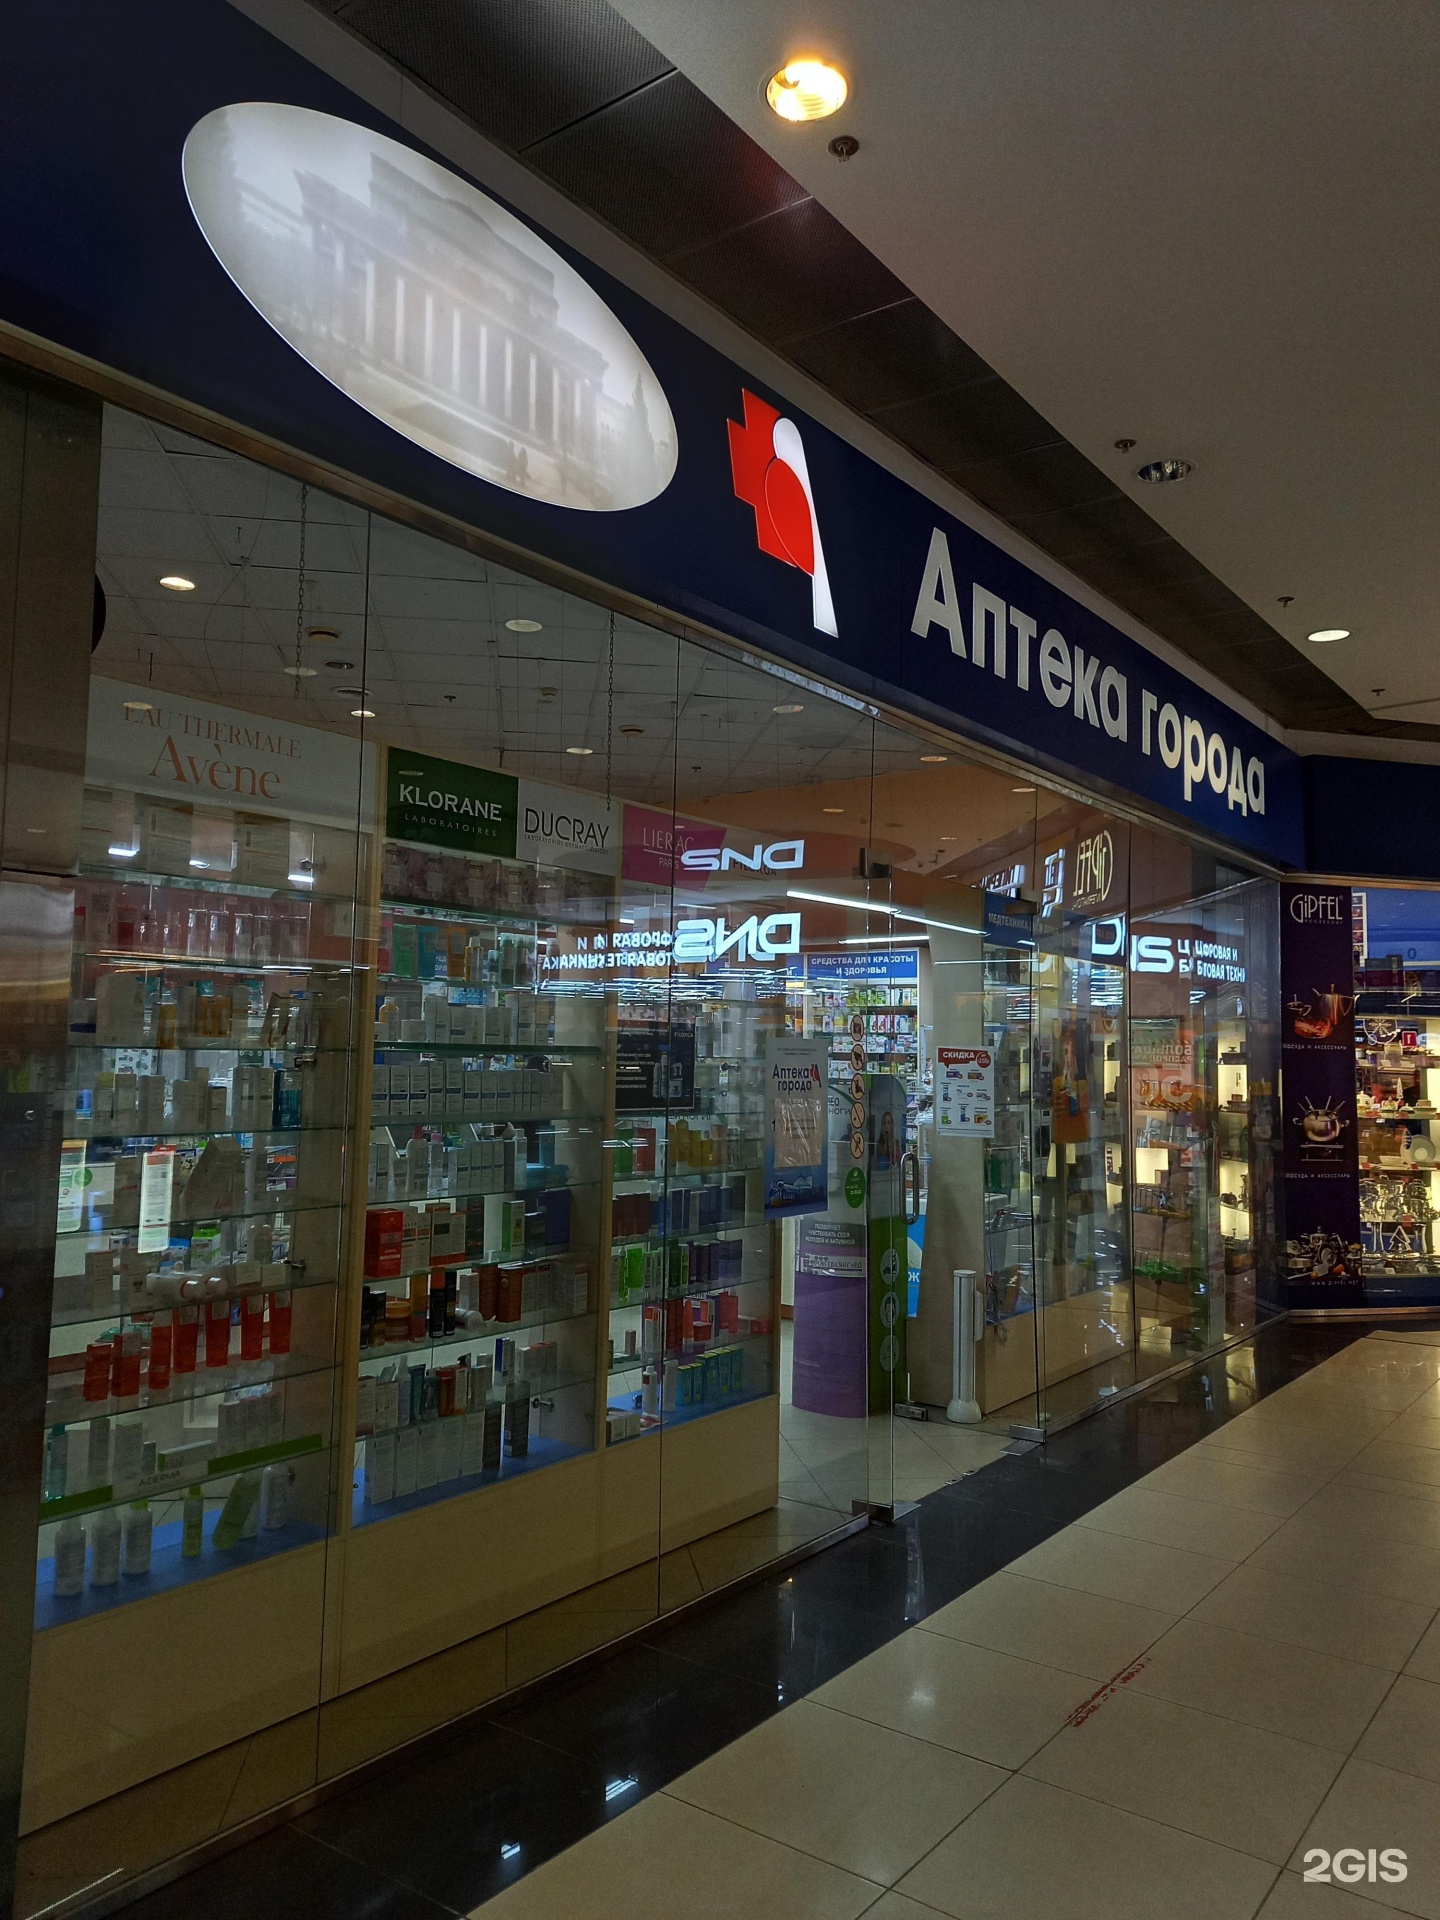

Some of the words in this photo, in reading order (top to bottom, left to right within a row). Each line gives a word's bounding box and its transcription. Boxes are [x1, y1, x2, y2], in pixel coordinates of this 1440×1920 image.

[911, 527, 1128, 743] Аптека
[1142, 689, 1265, 816] города
[124, 702, 172, 731] EAU
[178, 715, 301, 759] THERMALE
[148, 735, 281, 799] Avène
[399, 783, 503, 822] KLORANE
[405, 813, 497, 838] LABORATOIRES
[525, 808, 609, 848] DUCRAY
[643, 826, 694, 853] LIERAC
[811, 955, 852, 966] СРЕДСТВА
[872, 954, 914, 965] КРАСОТЫ
[836, 967, 843, 975] И
[844, 966, 887, 975] ЗДОРОВЬЯ
[943, 1051, 975, 1059] СКИДКА
[772, 1064, 810, 1080] Аптека
[778, 1080, 812, 1094] города
